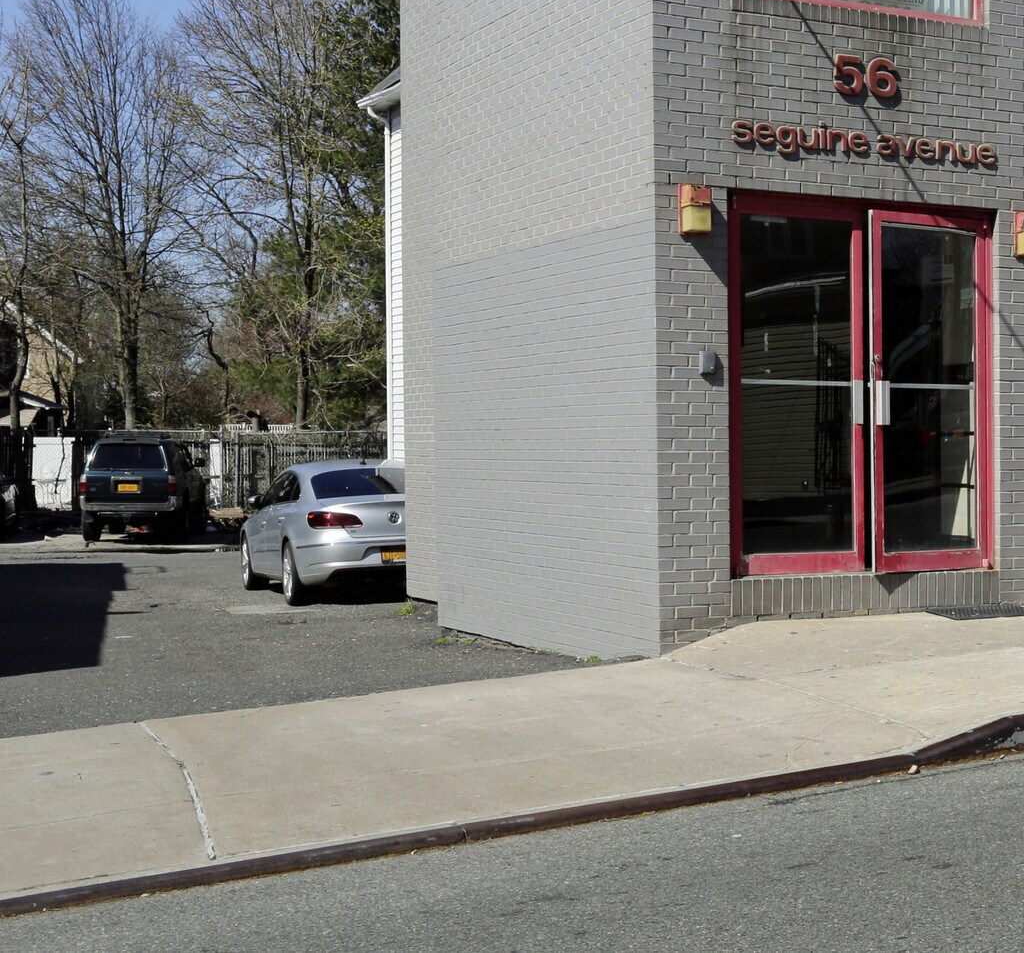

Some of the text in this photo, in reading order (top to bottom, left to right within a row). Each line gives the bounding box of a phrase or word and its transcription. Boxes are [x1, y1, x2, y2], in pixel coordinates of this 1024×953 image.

[833, 53, 898, 98] 56
[731, 119, 998, 166] seguine avenue
